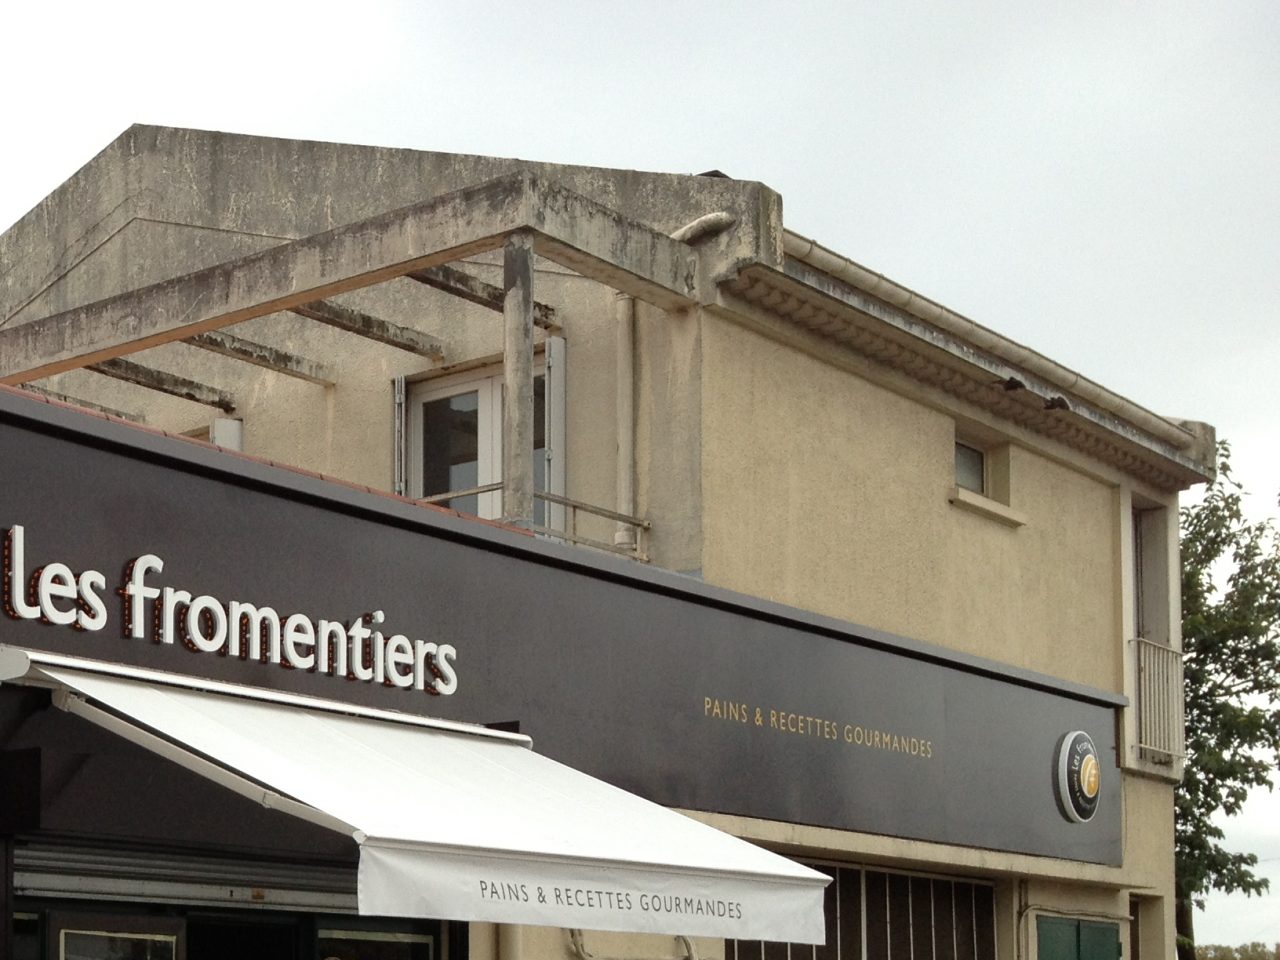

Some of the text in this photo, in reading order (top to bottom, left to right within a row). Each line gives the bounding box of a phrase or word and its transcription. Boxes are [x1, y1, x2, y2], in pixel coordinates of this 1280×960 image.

[11, 524, 458, 695] les fromentiers
[704, 696, 933, 758] PAINS & RECETTES GOURMANDES
[479, 880, 742, 920] PAINS & RECETTES GOURMANDES
